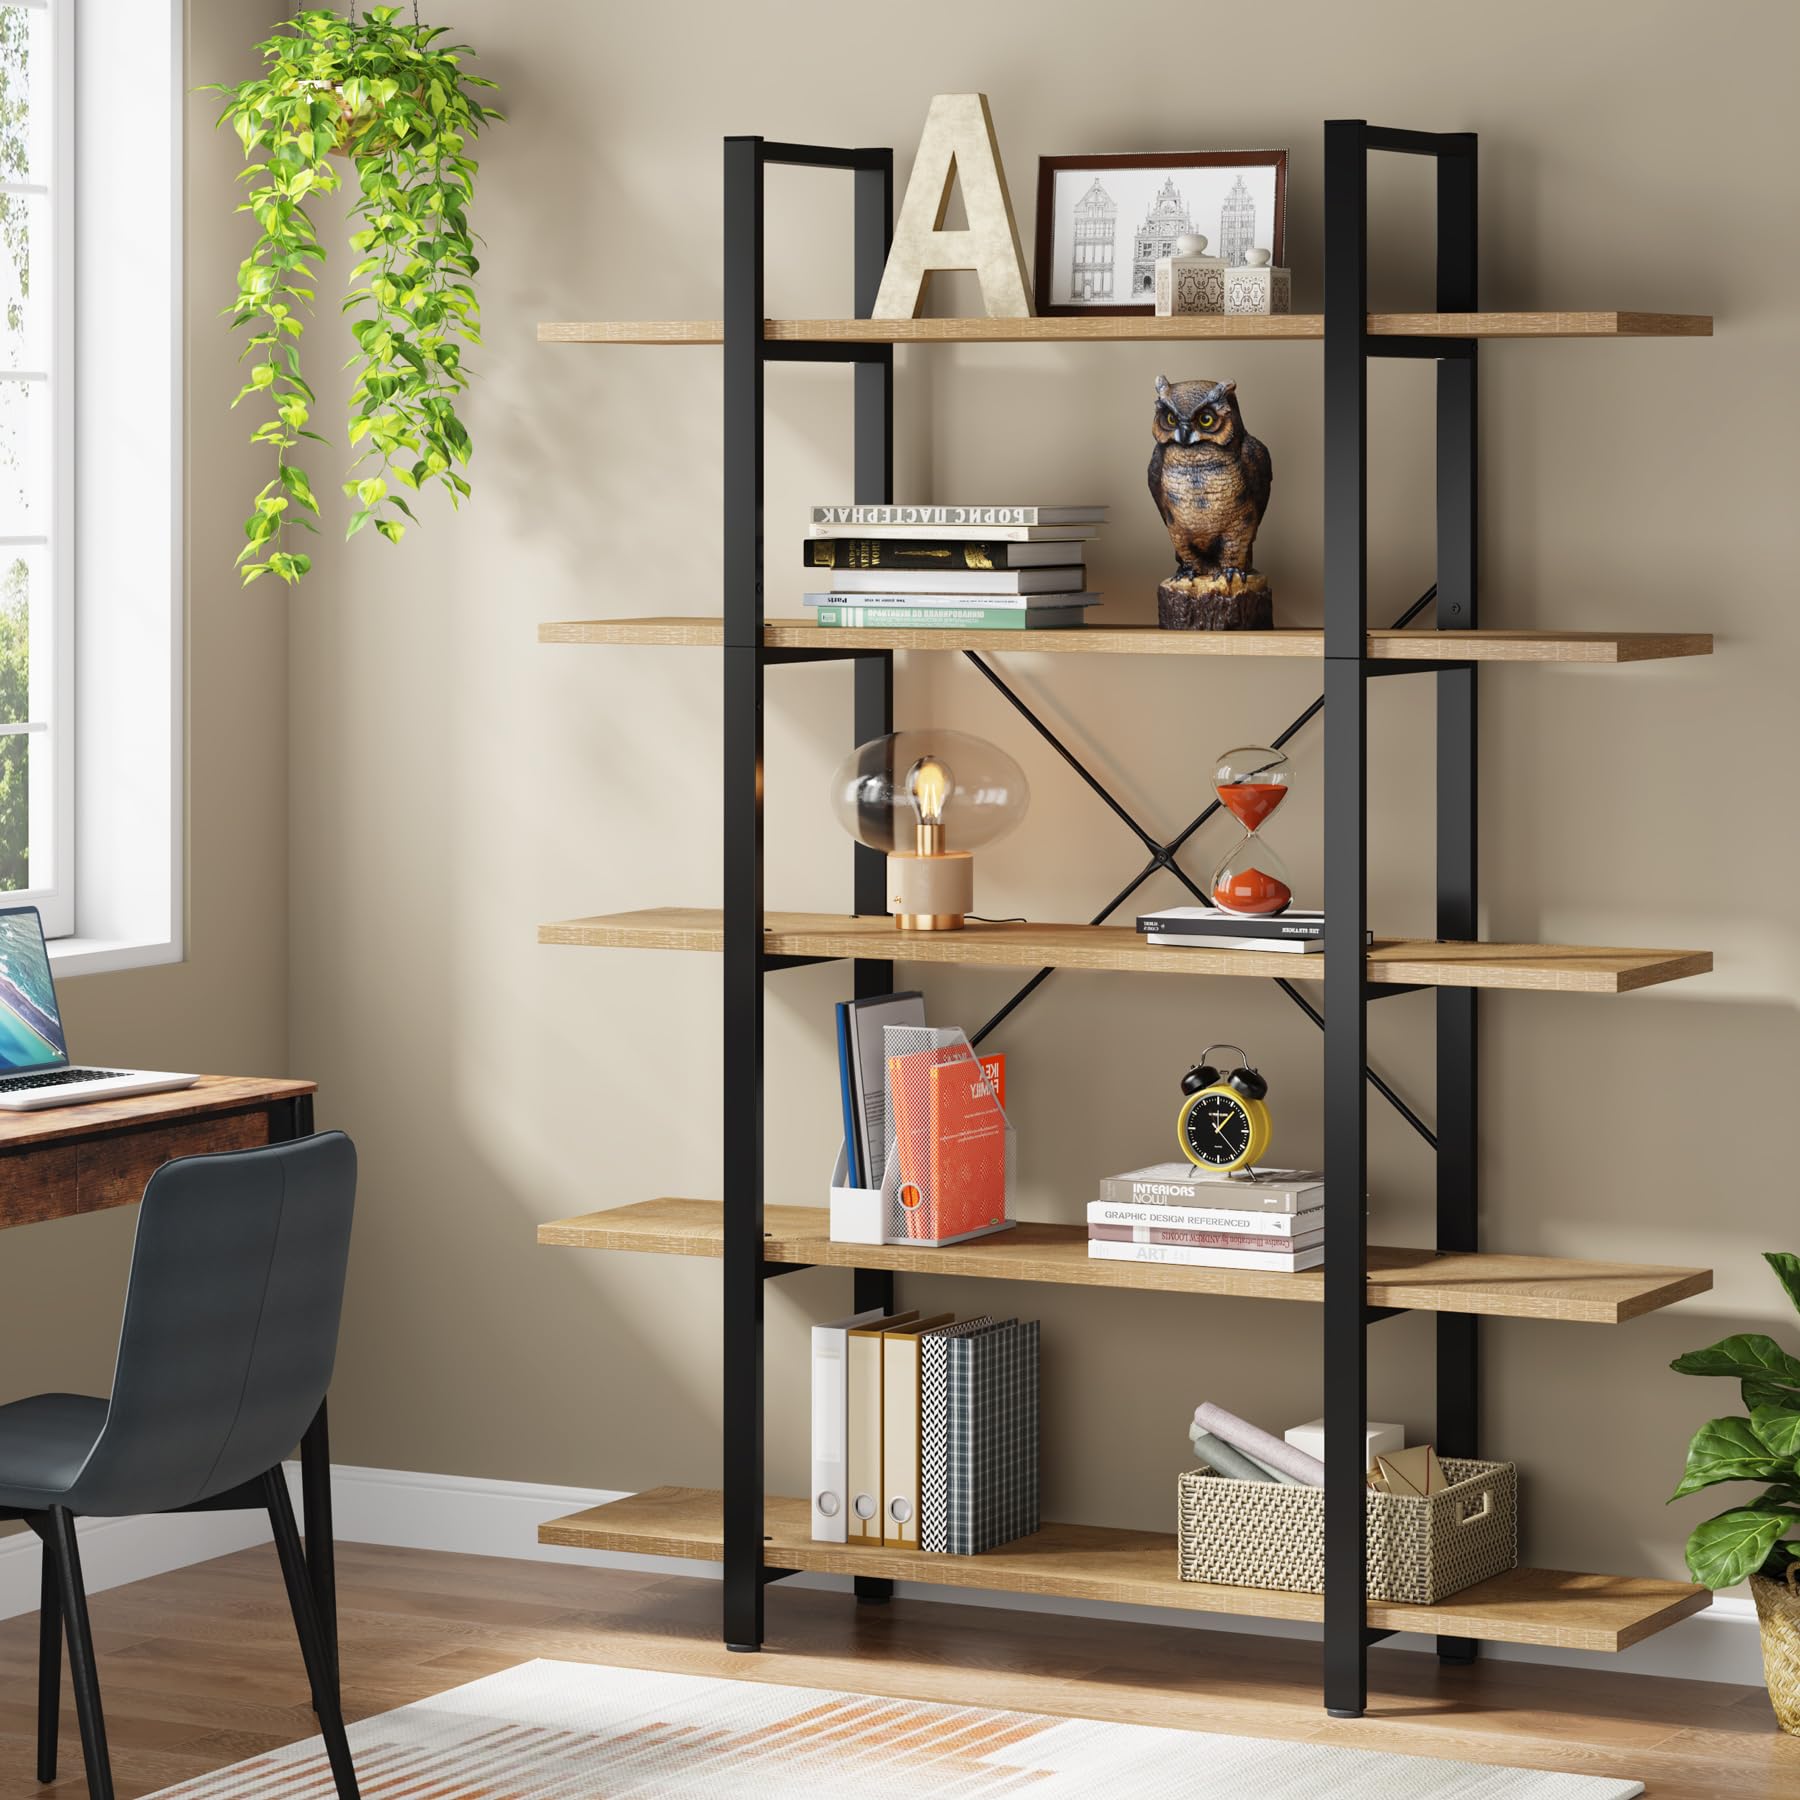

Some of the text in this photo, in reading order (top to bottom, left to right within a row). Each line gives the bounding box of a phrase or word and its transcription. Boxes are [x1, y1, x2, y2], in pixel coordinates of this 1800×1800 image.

[871, 92, 1036, 319] A
[820, 507, 1025, 524] БОРИС ПАСТЕРНАК
[1133, 1183, 1196, 1197] INTERIORS
[1133, 1193, 1168, 1206] NOW!
[1105, 1211, 1251, 1228] GRAPHIC DESIGN REFERENCED
[1161, 1231, 1187, 1241] LOOMIS
[1187, 1232, 1222, 1244] ANDREW
[1221, 1235, 1230, 1245] by
[1264, 1239, 1290, 1249] Creative
[1136, 1247, 1168, 1261] ART
